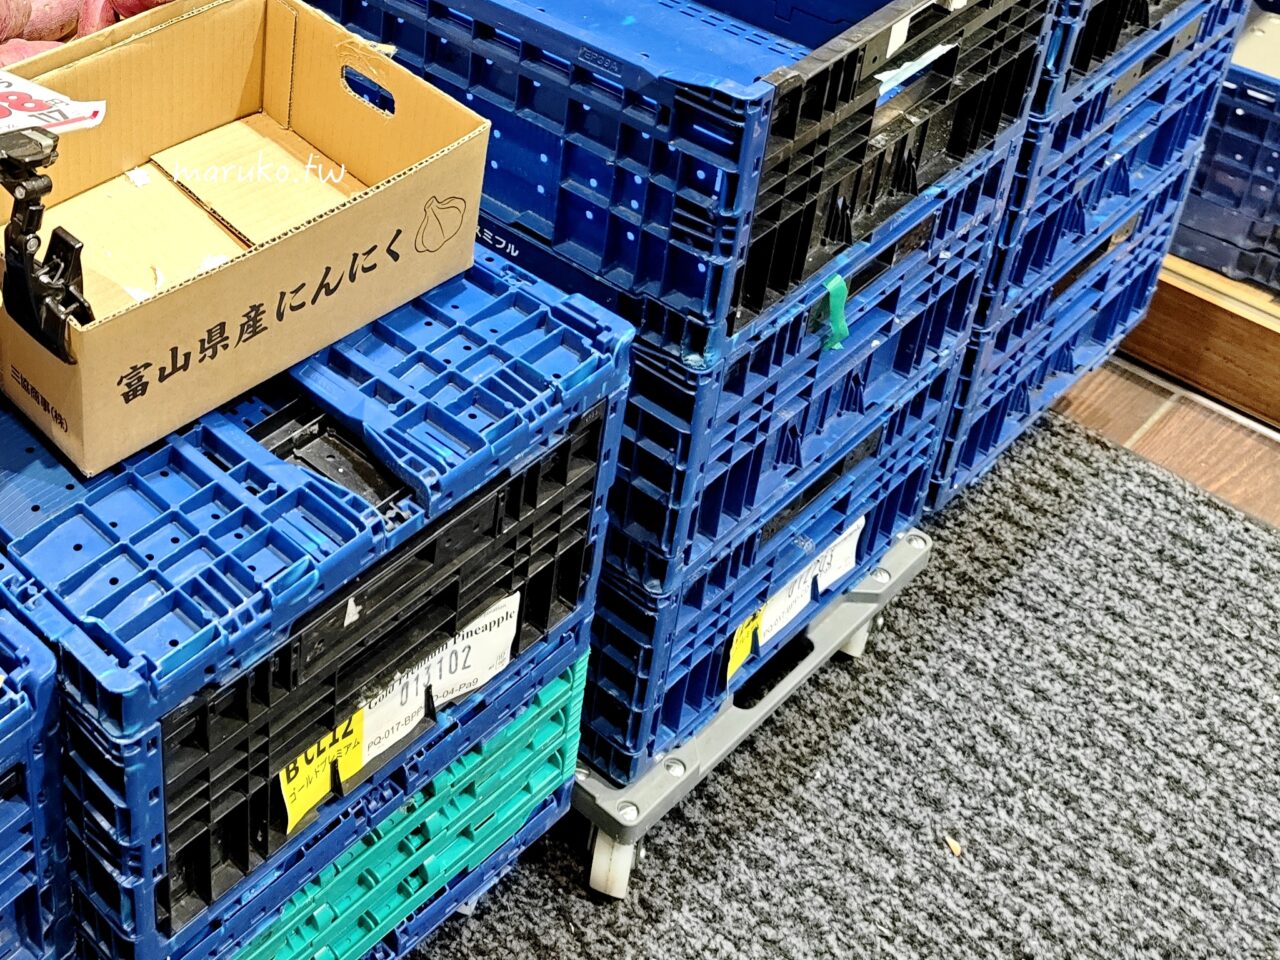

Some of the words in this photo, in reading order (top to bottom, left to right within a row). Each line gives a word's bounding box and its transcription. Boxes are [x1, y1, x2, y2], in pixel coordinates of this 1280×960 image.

[27, 108, 71, 124] 117
[116, 229, 404, 405] 富山県産にんにく
